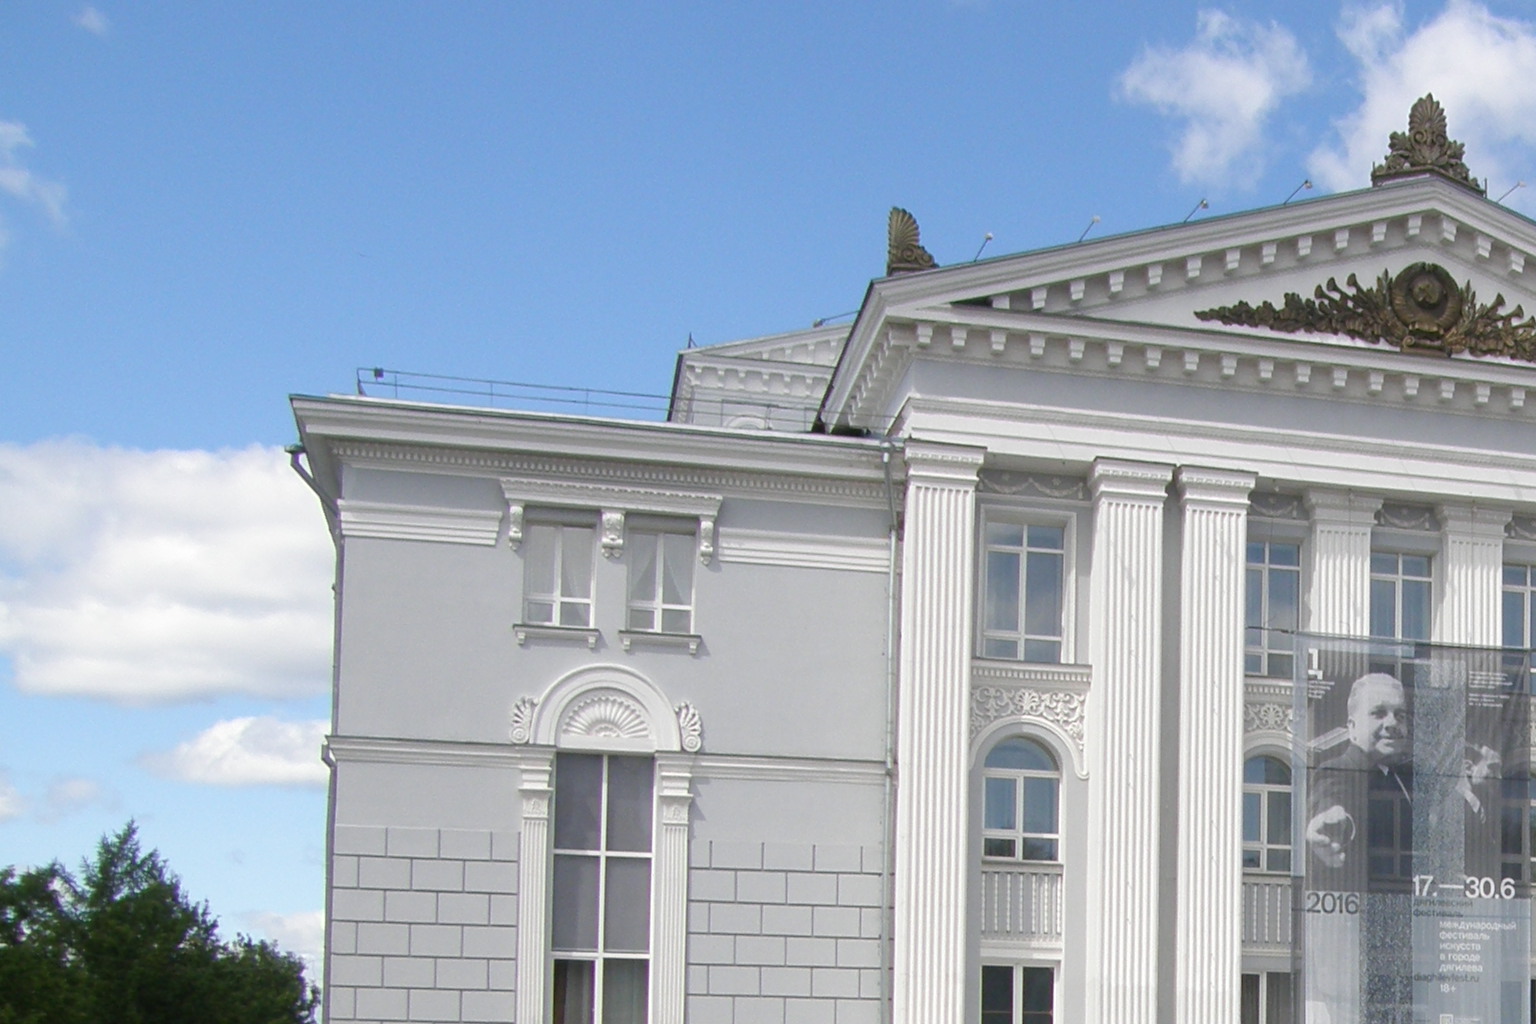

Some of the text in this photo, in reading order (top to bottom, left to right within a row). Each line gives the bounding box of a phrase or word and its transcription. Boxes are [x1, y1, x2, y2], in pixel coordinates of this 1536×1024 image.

[1306, 891, 1359, 915] 2016
[1440, 920, 1517, 931] международный
[1440, 931, 1490, 940] фестиваль
[1448, 953, 1481, 962] городе
[1440, 983, 1457, 993] 18+
